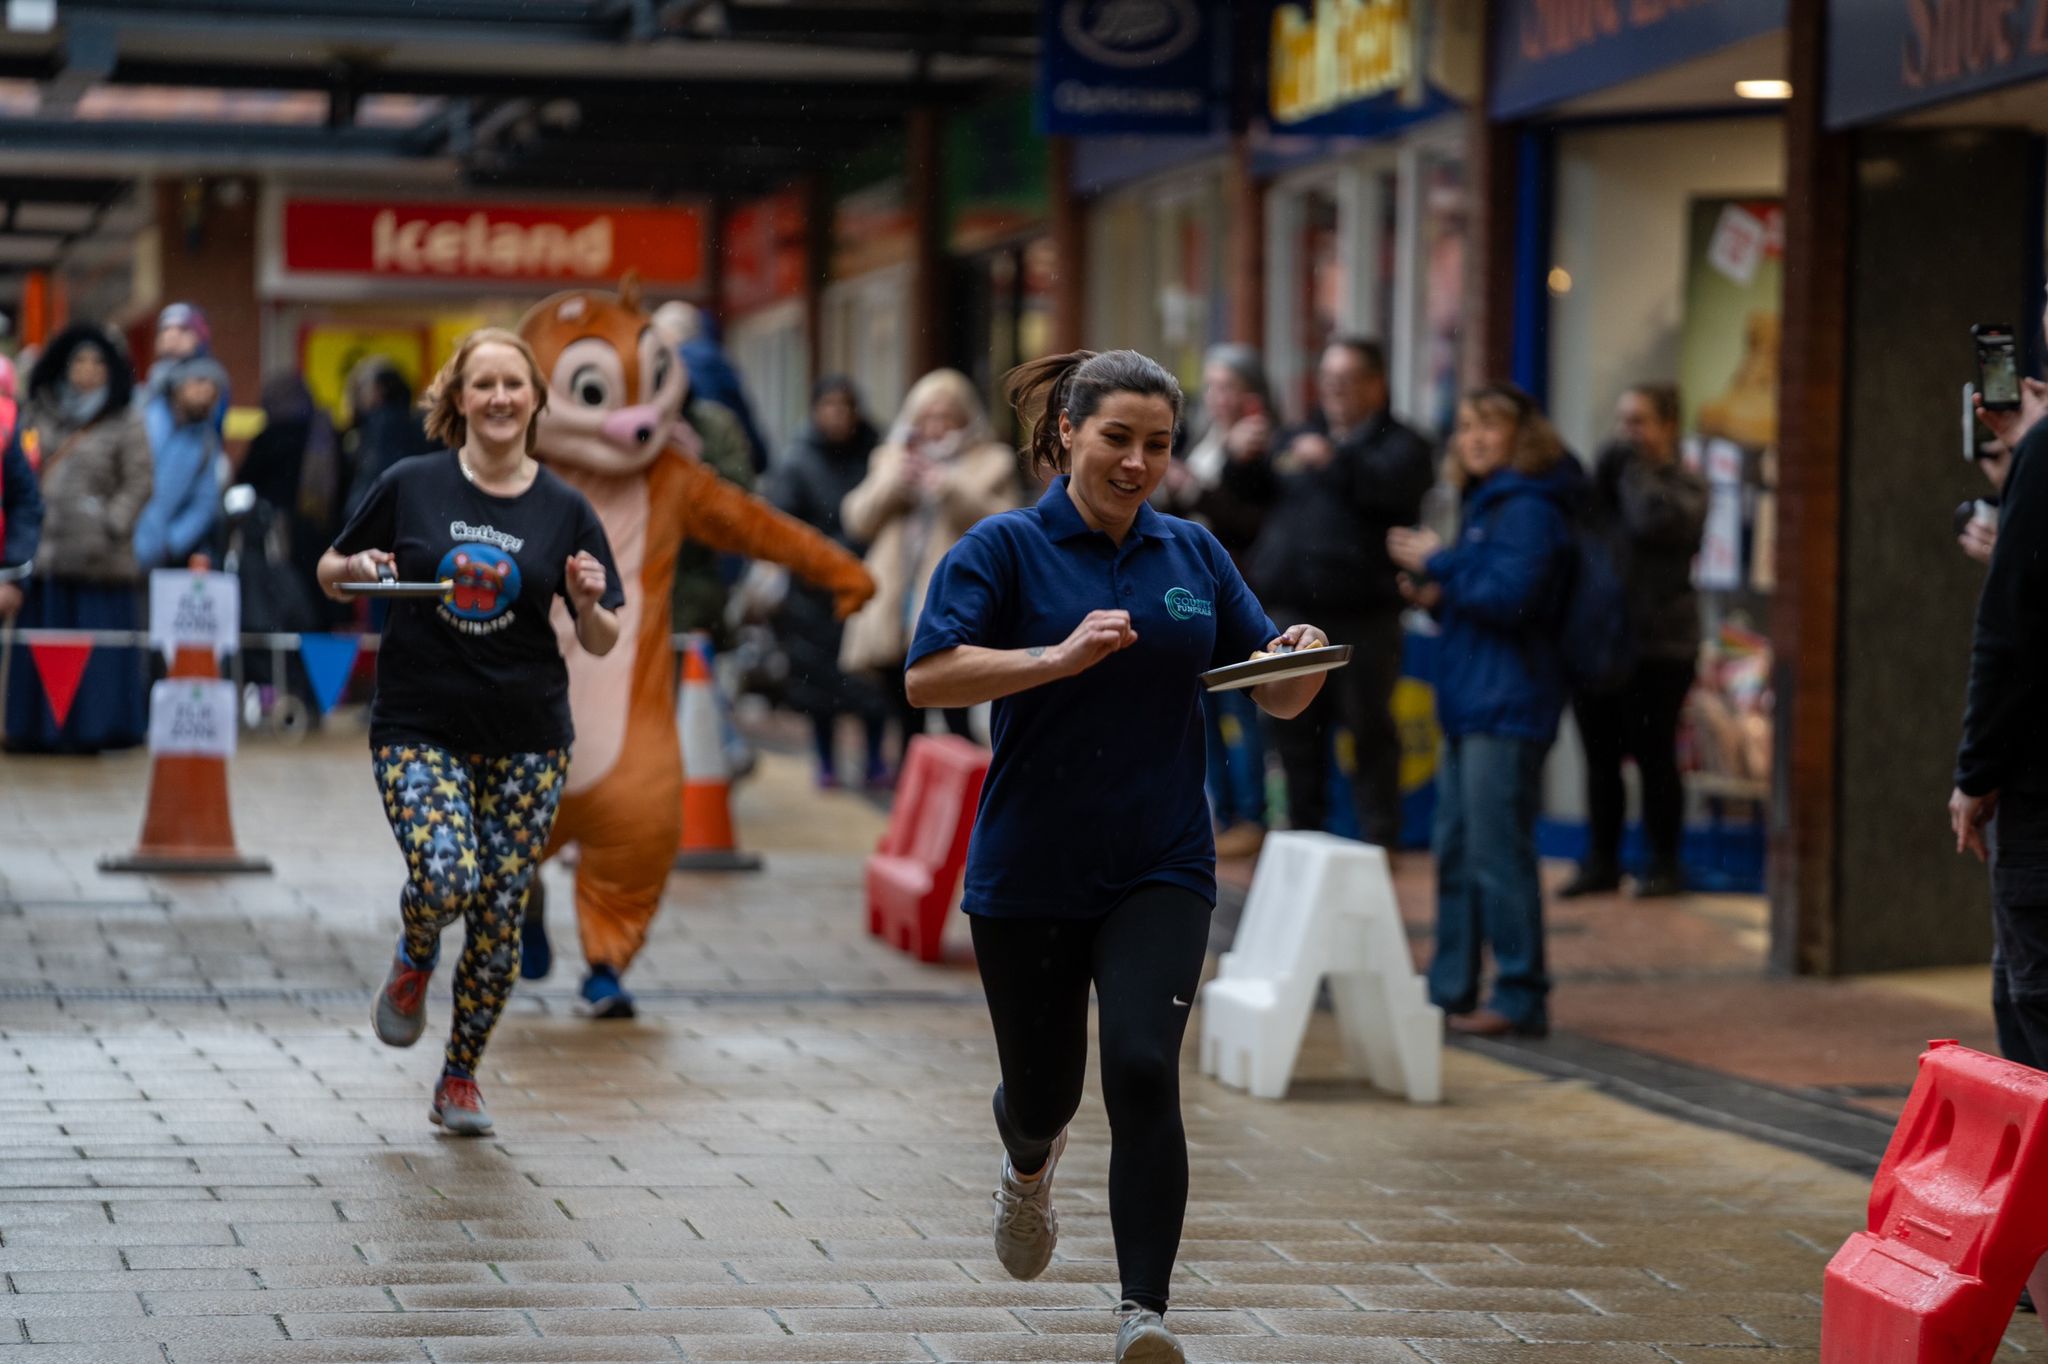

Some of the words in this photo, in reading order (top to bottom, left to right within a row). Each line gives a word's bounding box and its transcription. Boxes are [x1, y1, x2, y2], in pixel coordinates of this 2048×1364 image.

[372, 209, 613, 276] Iceland
[1173, 597, 1212, 609] COUNTY
[1177, 604, 1212, 616] FUNERALS
[436, 605, 516, 635] IMAGINATOR
